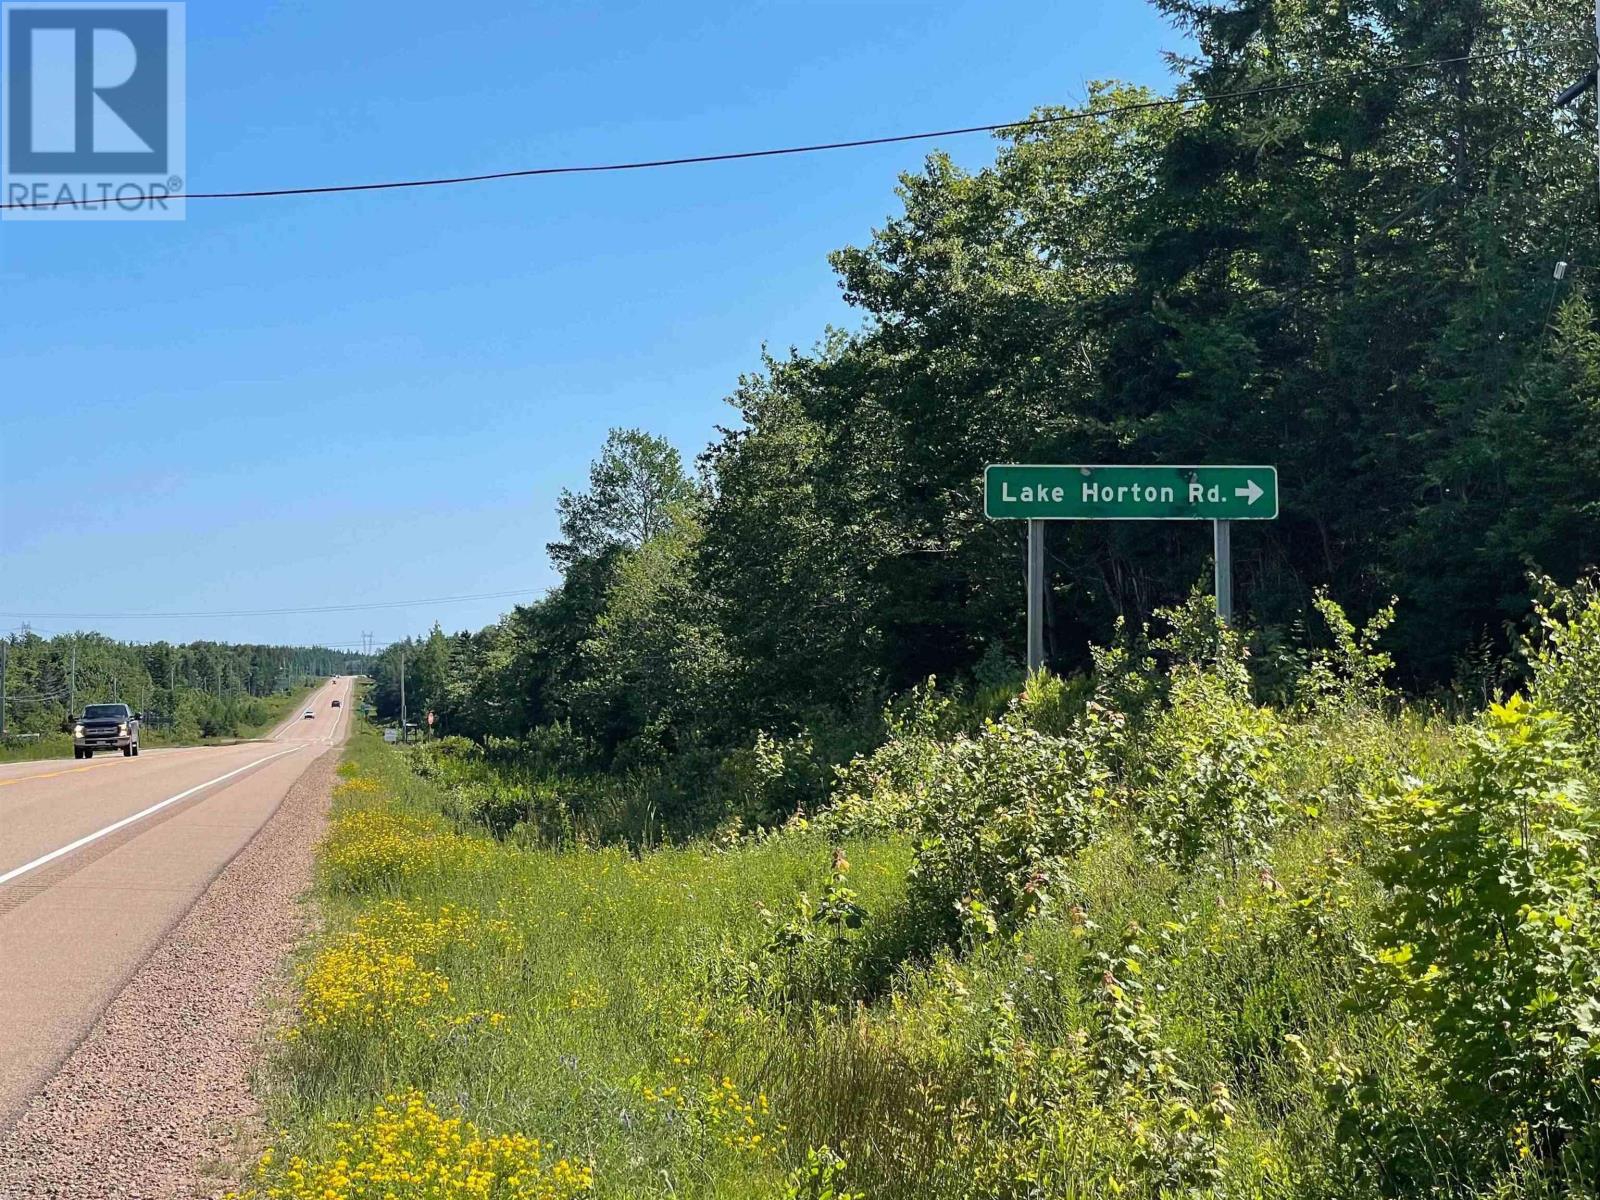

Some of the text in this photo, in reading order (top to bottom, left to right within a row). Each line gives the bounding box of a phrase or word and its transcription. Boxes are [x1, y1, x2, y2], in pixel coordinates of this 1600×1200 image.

[1001, 482, 1228, 503] Lake Horton Rd.
